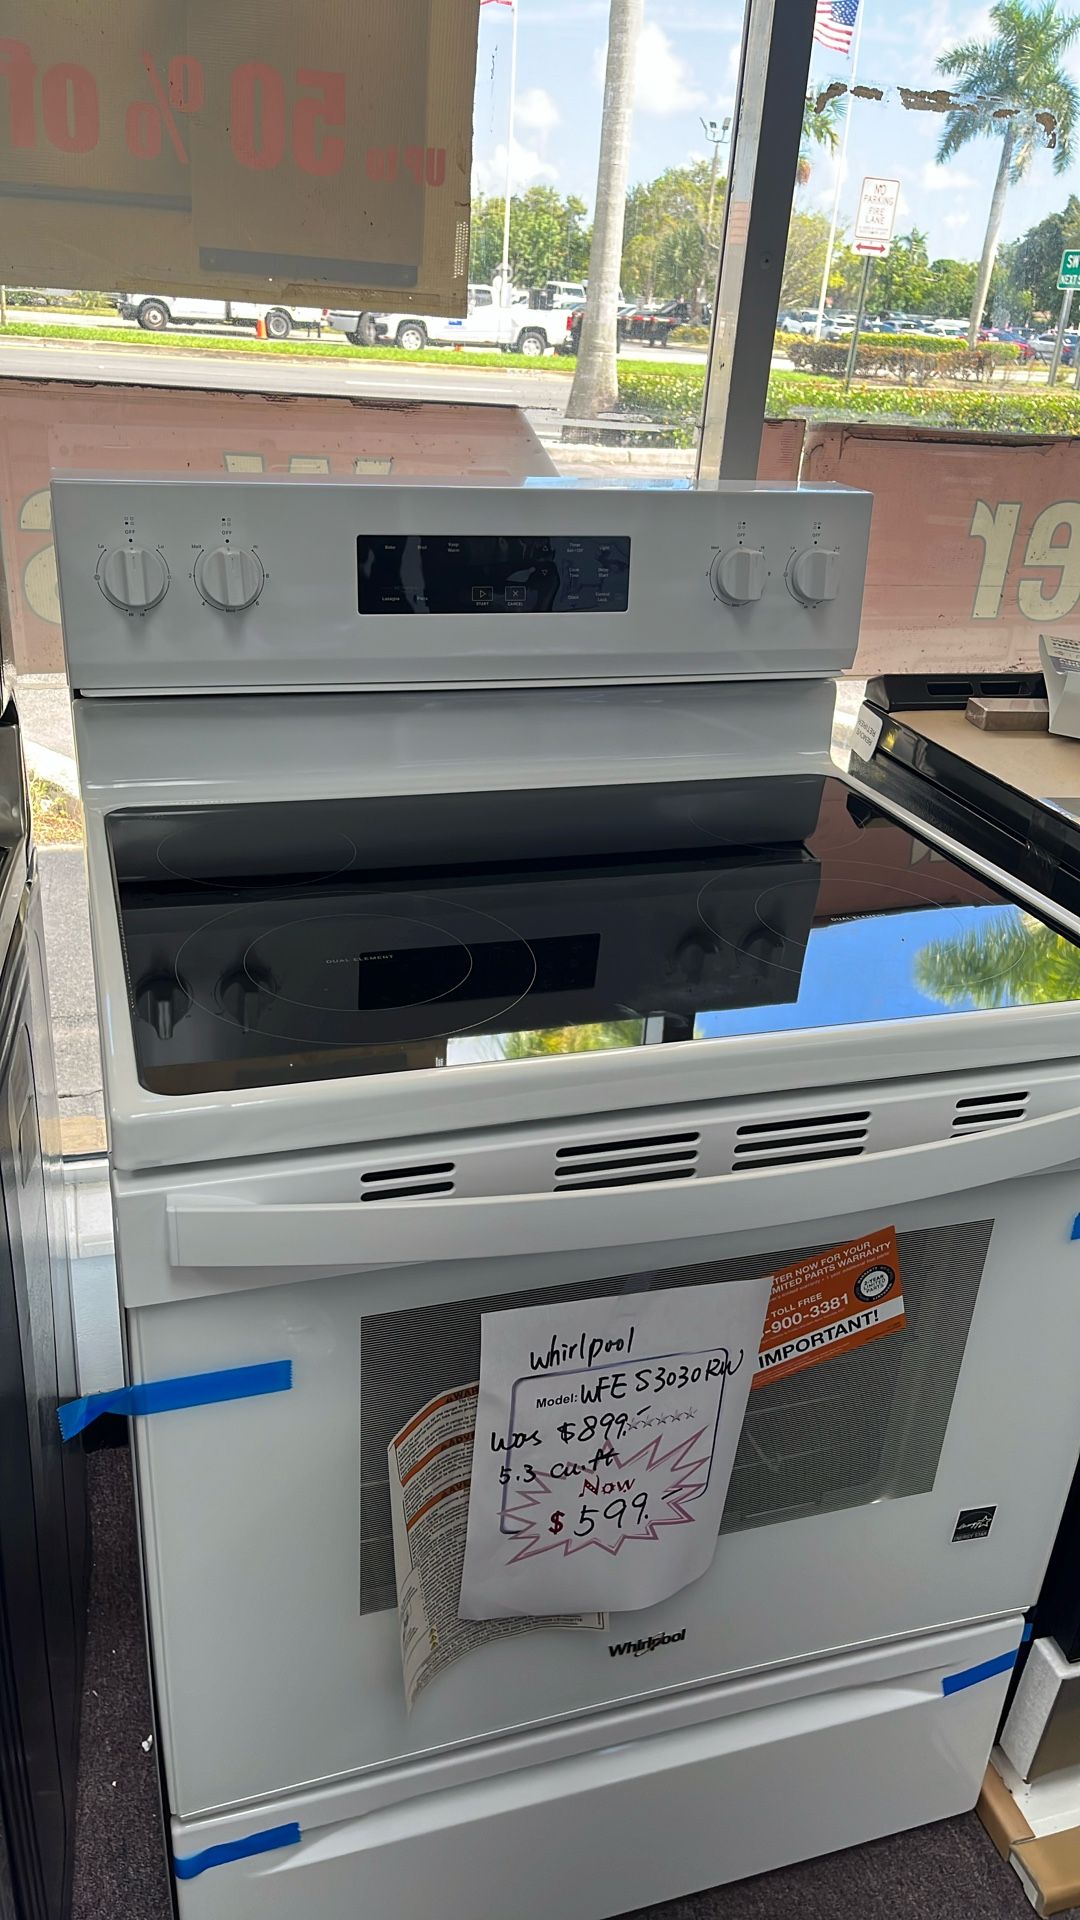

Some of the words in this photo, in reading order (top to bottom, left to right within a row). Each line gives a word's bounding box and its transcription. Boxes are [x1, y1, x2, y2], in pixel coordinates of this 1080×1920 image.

[863, 194, 895, 206] PARKING
[874, 184, 887, 195] NO
[865, 215, 886, 225] LANE
[868, 206, 886, 217] FIRE
[795, 1261, 818, 1277] NOW
[821, 1253, 841, 1268] FOR
[843, 1241, 871, 1258] YOUR
[805, 1264, 835, 1281] PARTS
[838, 1241, 891, 1268] WARRANTY
[764, 1292, 848, 1335] -900-3381
[771, 1304, 796, 1319] TOLL
[798, 1292, 823, 1308] FREE
[758, 1309, 879, 1369] IMPORTANT!
[536, 1393, 578, 1409] Model:
[499, 1464, 537, 1485] 5.3
[608, 1628, 686, 1657] Whirlpool
